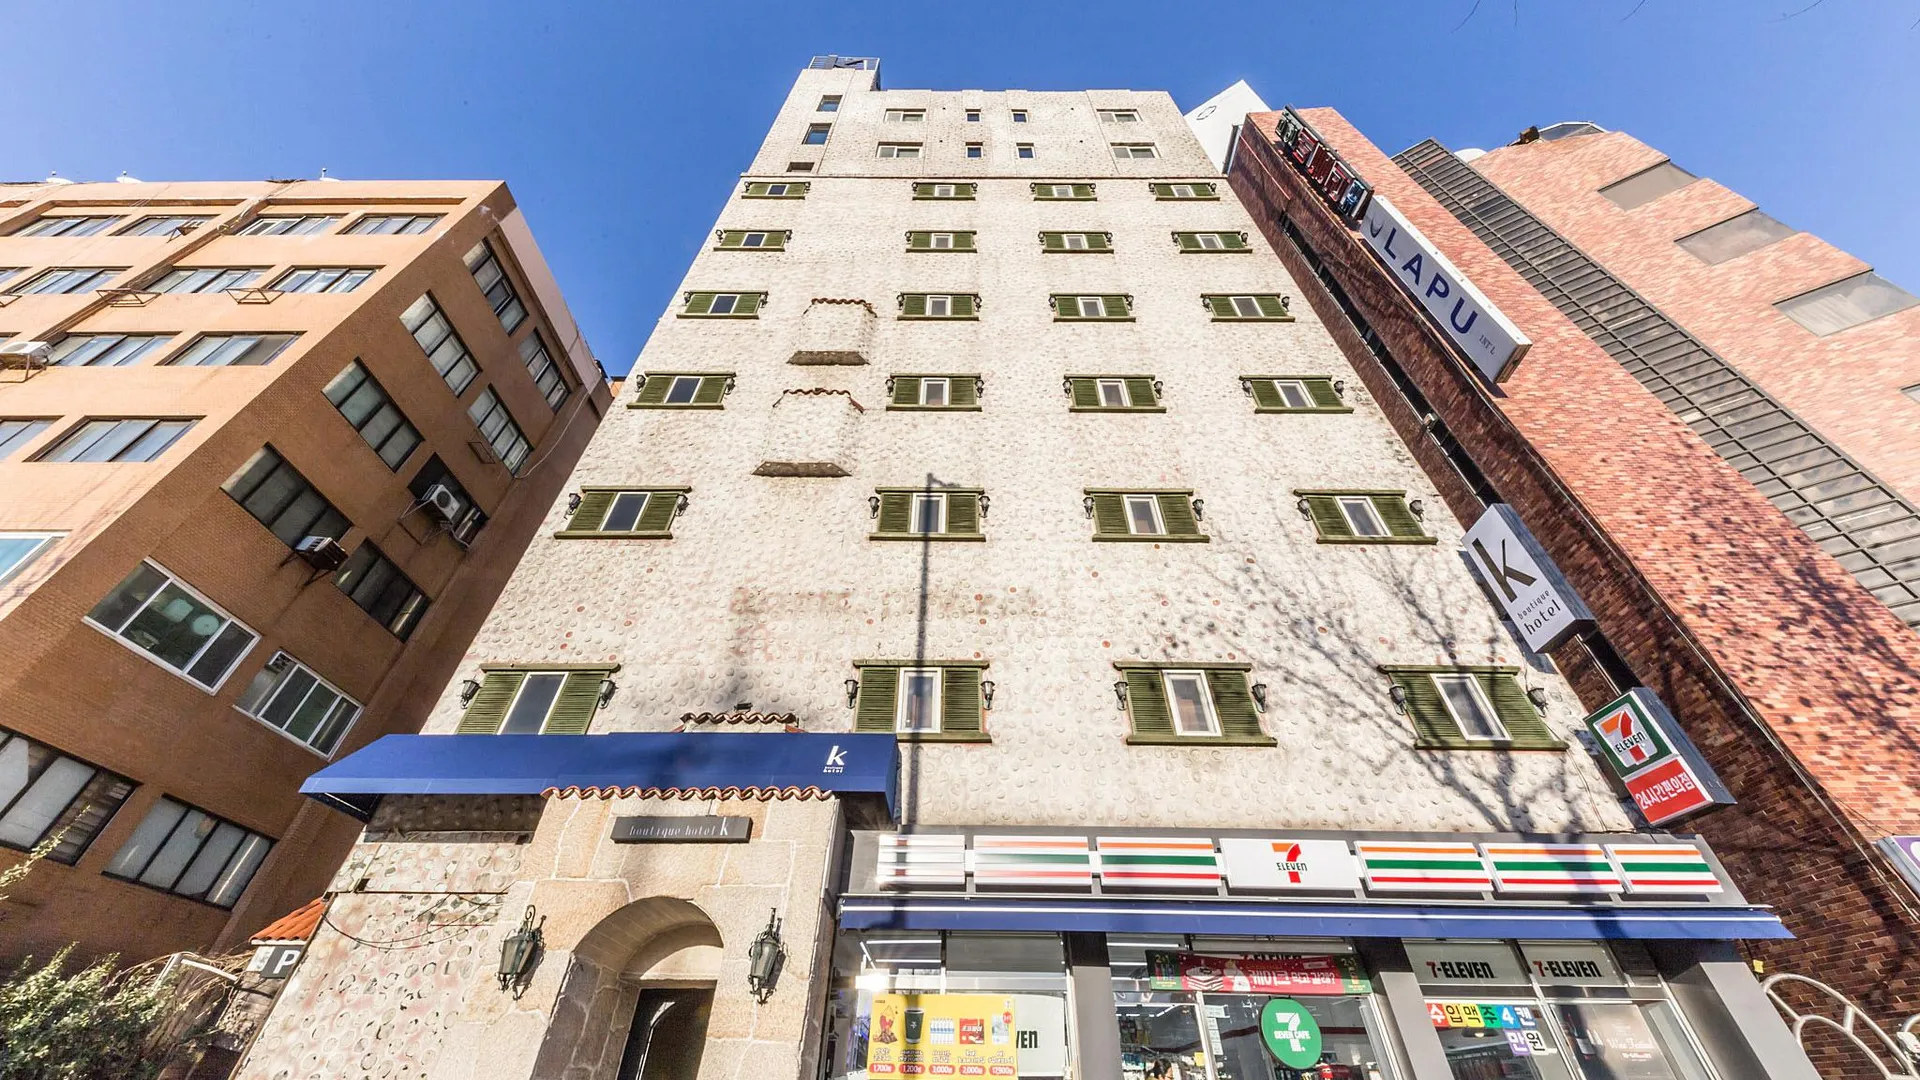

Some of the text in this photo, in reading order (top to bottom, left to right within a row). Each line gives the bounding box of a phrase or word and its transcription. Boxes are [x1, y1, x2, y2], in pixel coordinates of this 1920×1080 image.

[1384, 228, 1478, 334] LAPU
[1518, 590, 1550, 620] boutique
[1524, 599, 1561, 635] hotel
[1635, 772, 1696, 810] 24시간편의점
[630, 825, 680, 838] boutique
[685, 825, 716, 836] hotel
[273, 949, 300, 974] P
[1507, 1032, 1546, 1053] 만원
